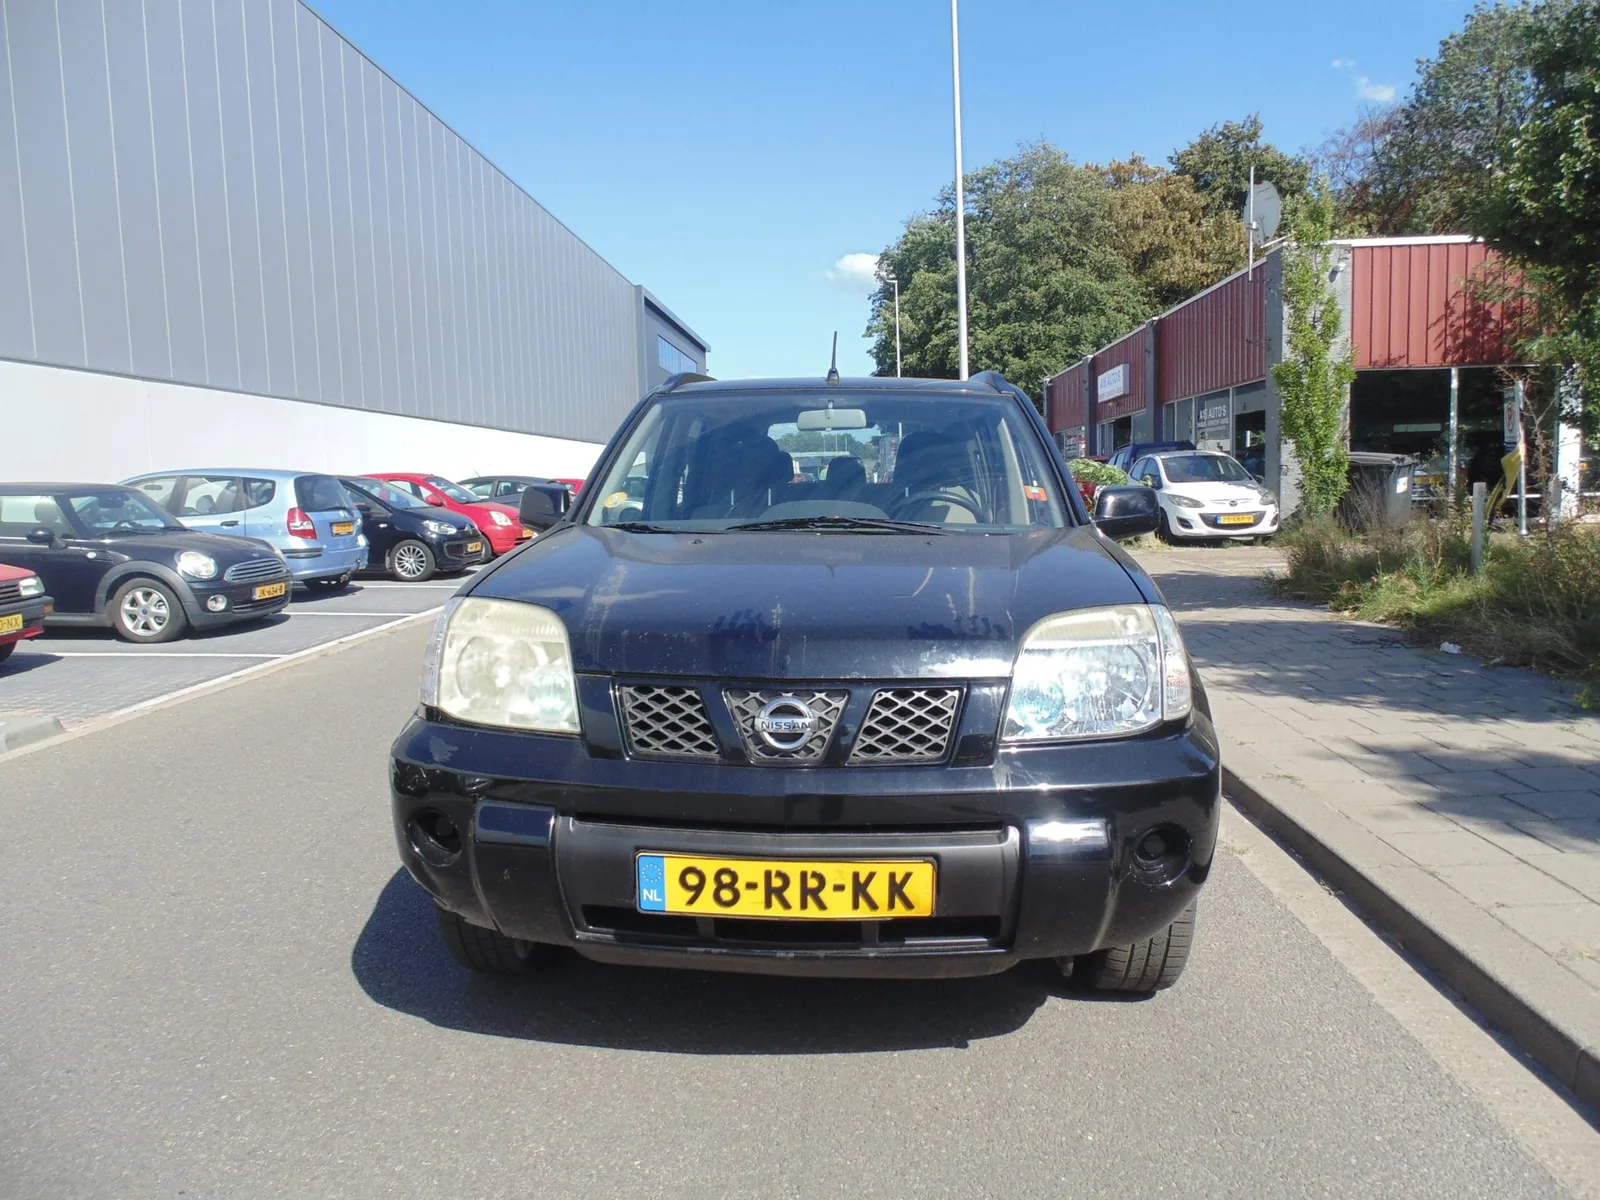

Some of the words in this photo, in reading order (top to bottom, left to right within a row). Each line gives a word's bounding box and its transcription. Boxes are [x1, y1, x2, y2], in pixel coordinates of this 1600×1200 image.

[761, 720, 811, 730] NISSAN
[643, 888, 662, 902] NL
[678, 865, 915, 912] 98-RR-KK
